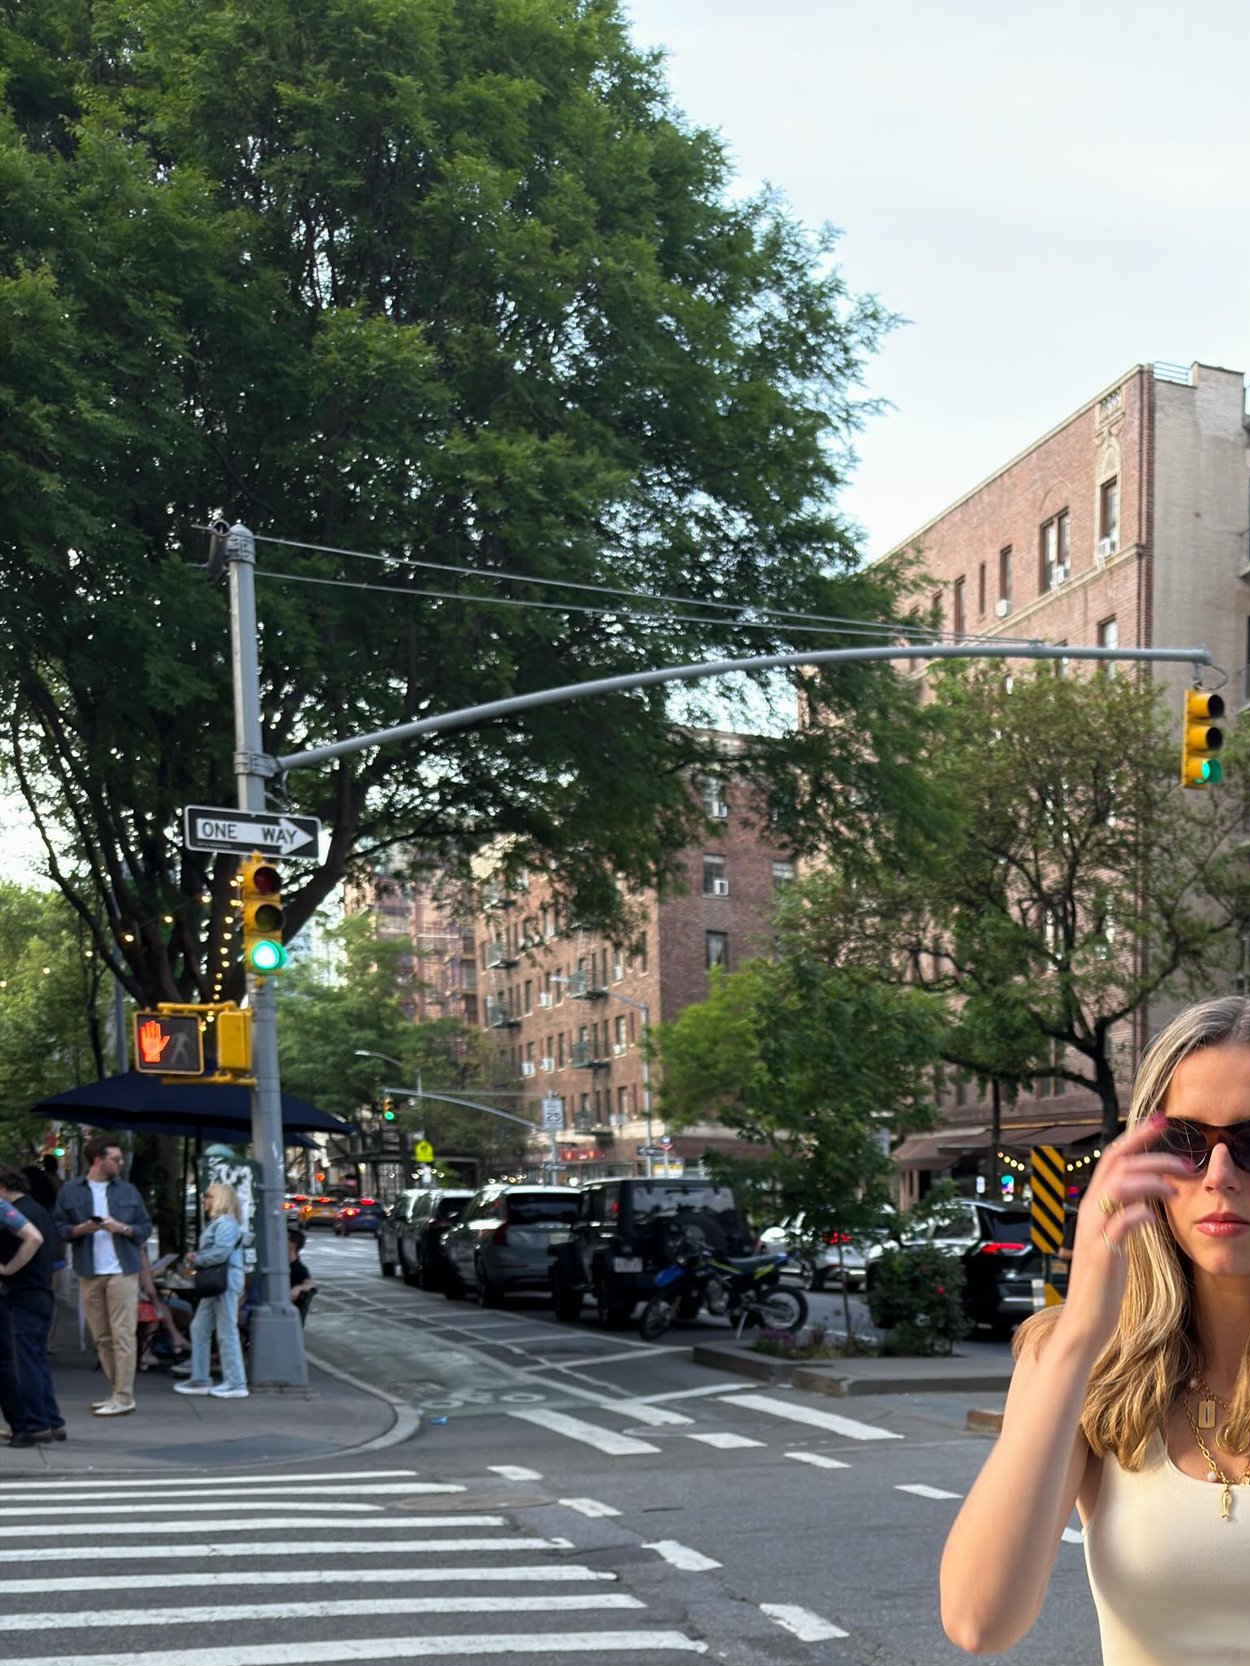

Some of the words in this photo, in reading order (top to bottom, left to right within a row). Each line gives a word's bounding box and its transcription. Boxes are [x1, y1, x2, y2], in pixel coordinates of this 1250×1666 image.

[202, 821, 238, 840] ONE
[262, 826, 298, 845] WAY
[546, 1112, 561, 1122] 25
